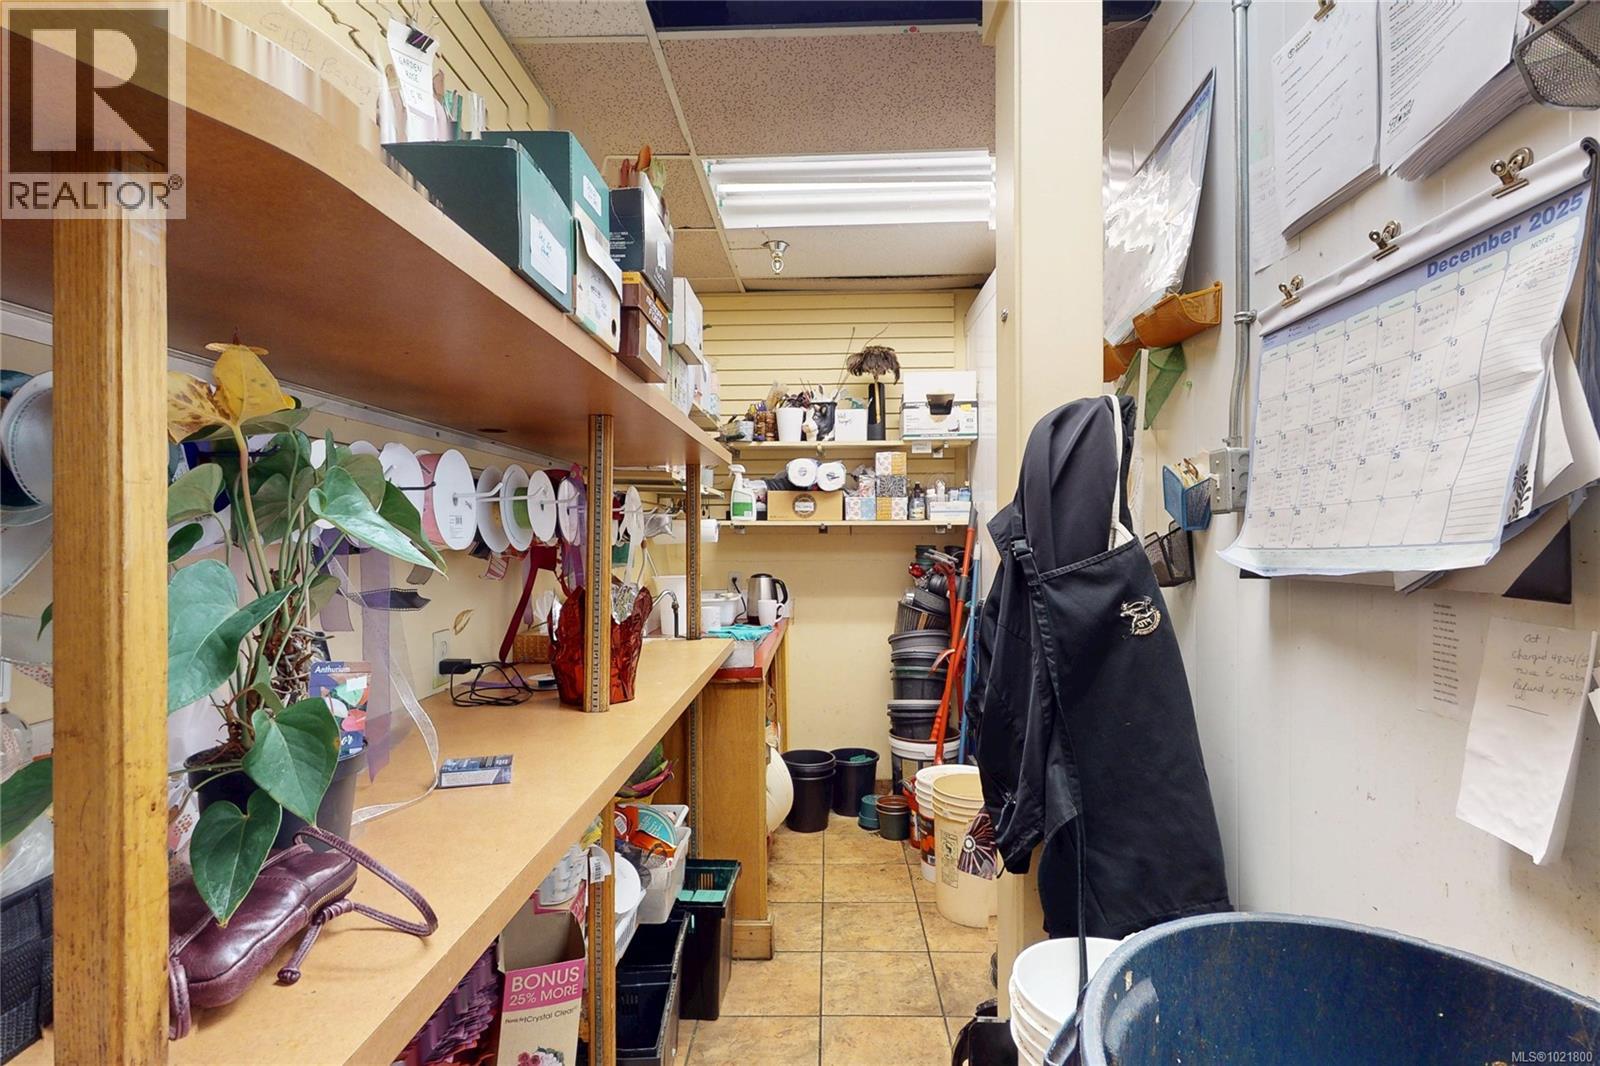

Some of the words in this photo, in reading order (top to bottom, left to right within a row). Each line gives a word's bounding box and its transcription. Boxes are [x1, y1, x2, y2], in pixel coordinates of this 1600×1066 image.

[1425, 224, 1523, 279] December
[1527, 193, 1584, 233] 2025
[1530, 232, 1556, 250] NOTES
[1416, 306, 1422, 314] 5
[1459, 288, 1466, 296] 6
[1374, 366, 1383, 374] 11
[1413, 353, 1423, 362] 12
[1403, 402, 1412, 411] 19
[1438, 391, 1448, 401] 20
[1358, 457, 1367, 466] 25
[1430, 443, 1440, 453] 27
[314, 665, 351, 674] Anthurium
[511, 965, 581, 993] BONUS
[508, 991, 537, 1007] 25%
[540, 983, 580, 1002] MORE
[526, 1012, 553, 1025] Crystal
